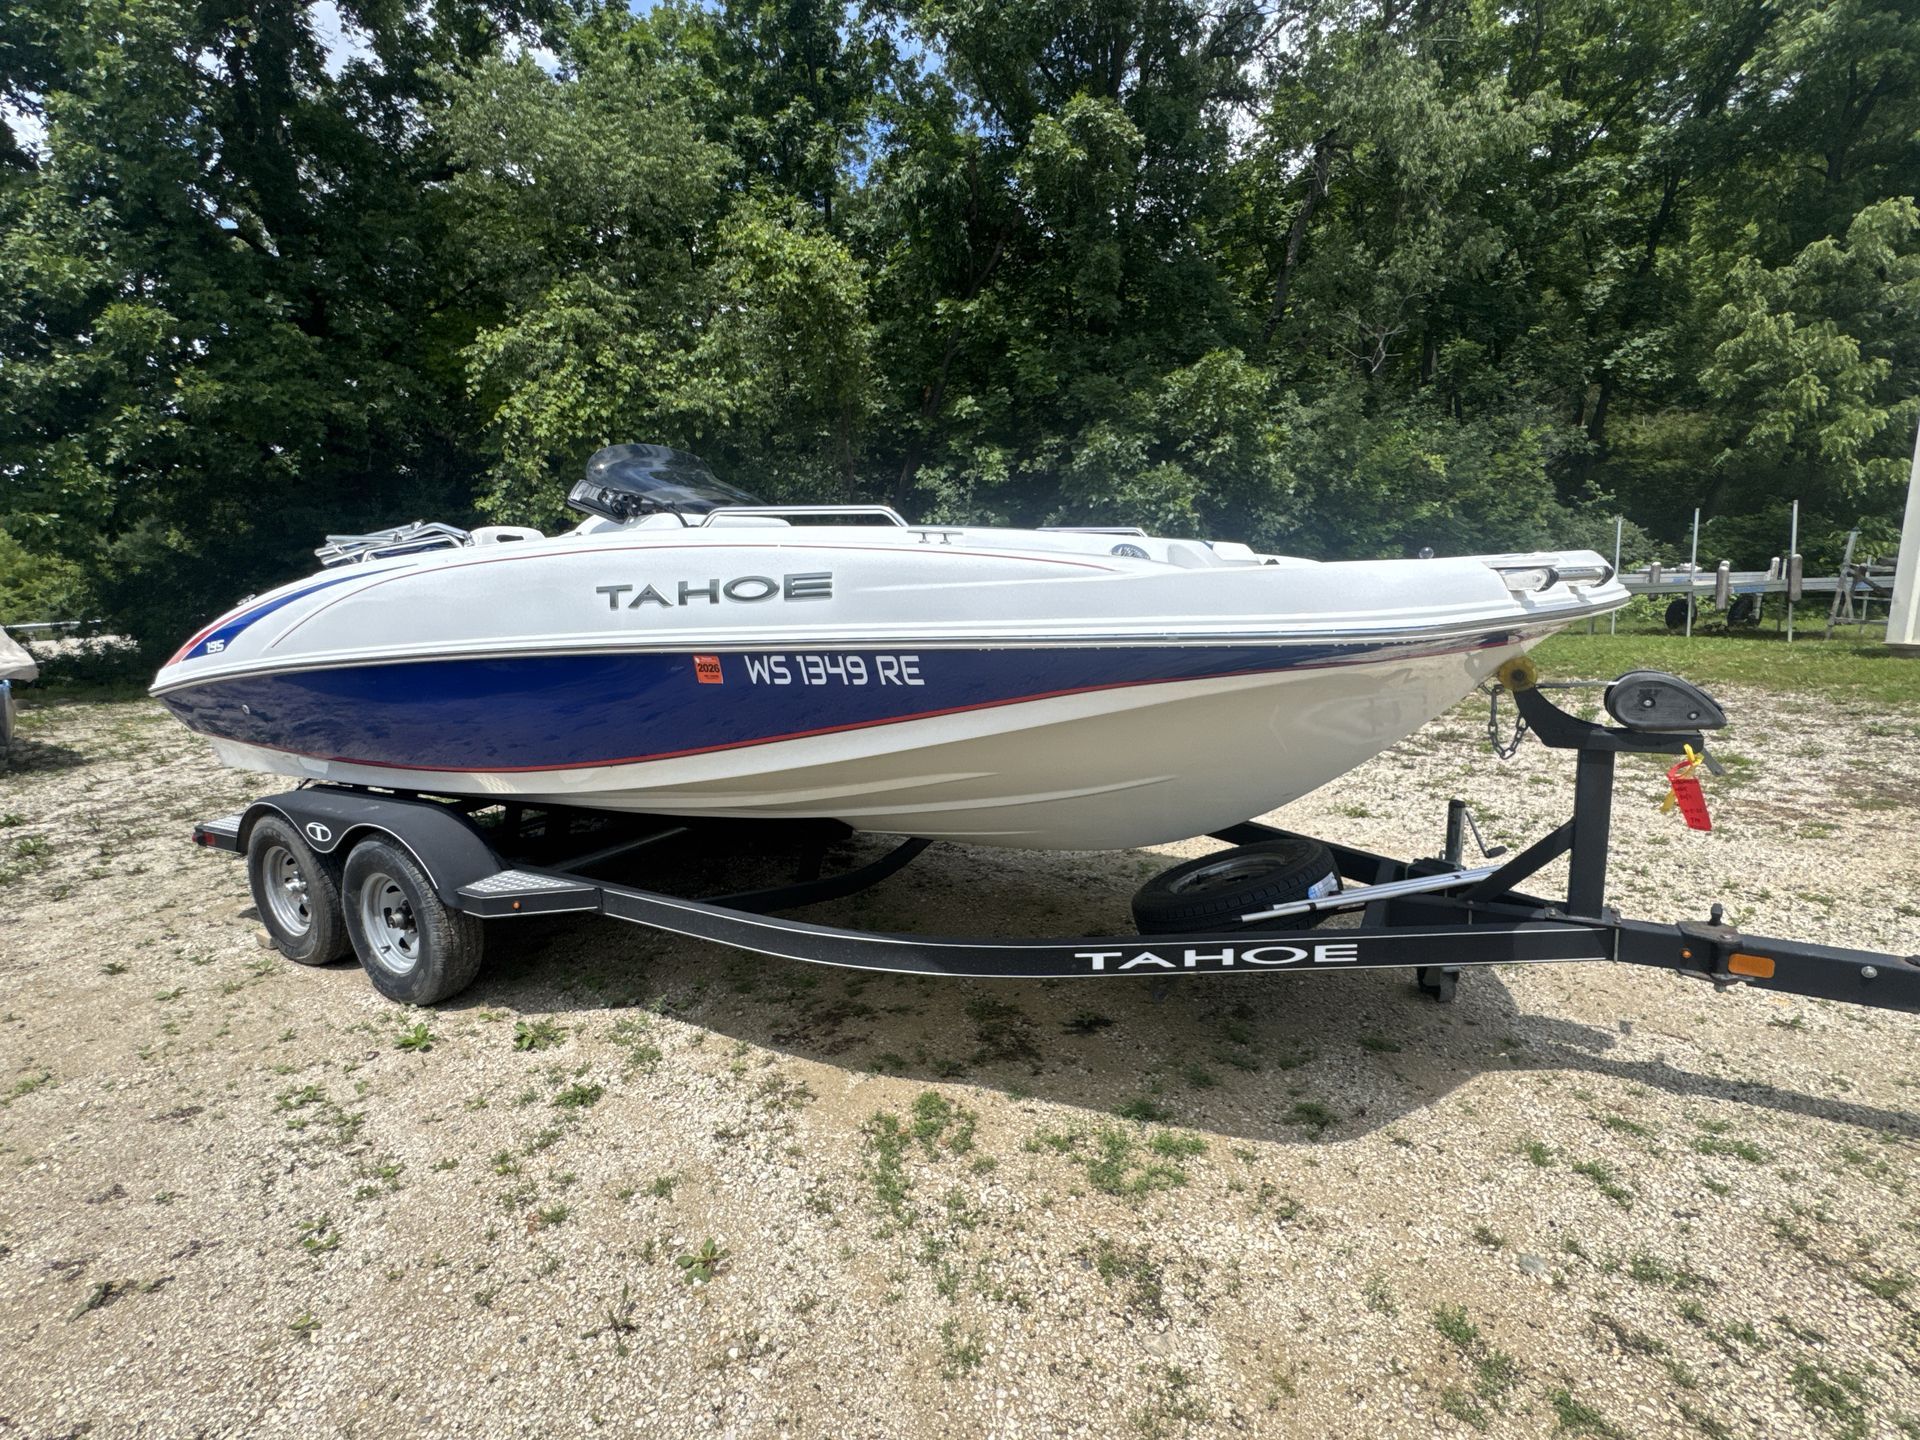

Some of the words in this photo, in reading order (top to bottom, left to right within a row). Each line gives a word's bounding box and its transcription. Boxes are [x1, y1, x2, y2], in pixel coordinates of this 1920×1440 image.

[596, 571, 833, 611] TAHOE
[206, 639, 225, 653] 195
[698, 663, 721, 673] 2026
[744, 655, 792, 685] WS
[795, 655, 868, 685] 1349
[875, 655, 925, 685] RE
[1074, 943, 1358, 970] TAHOE
